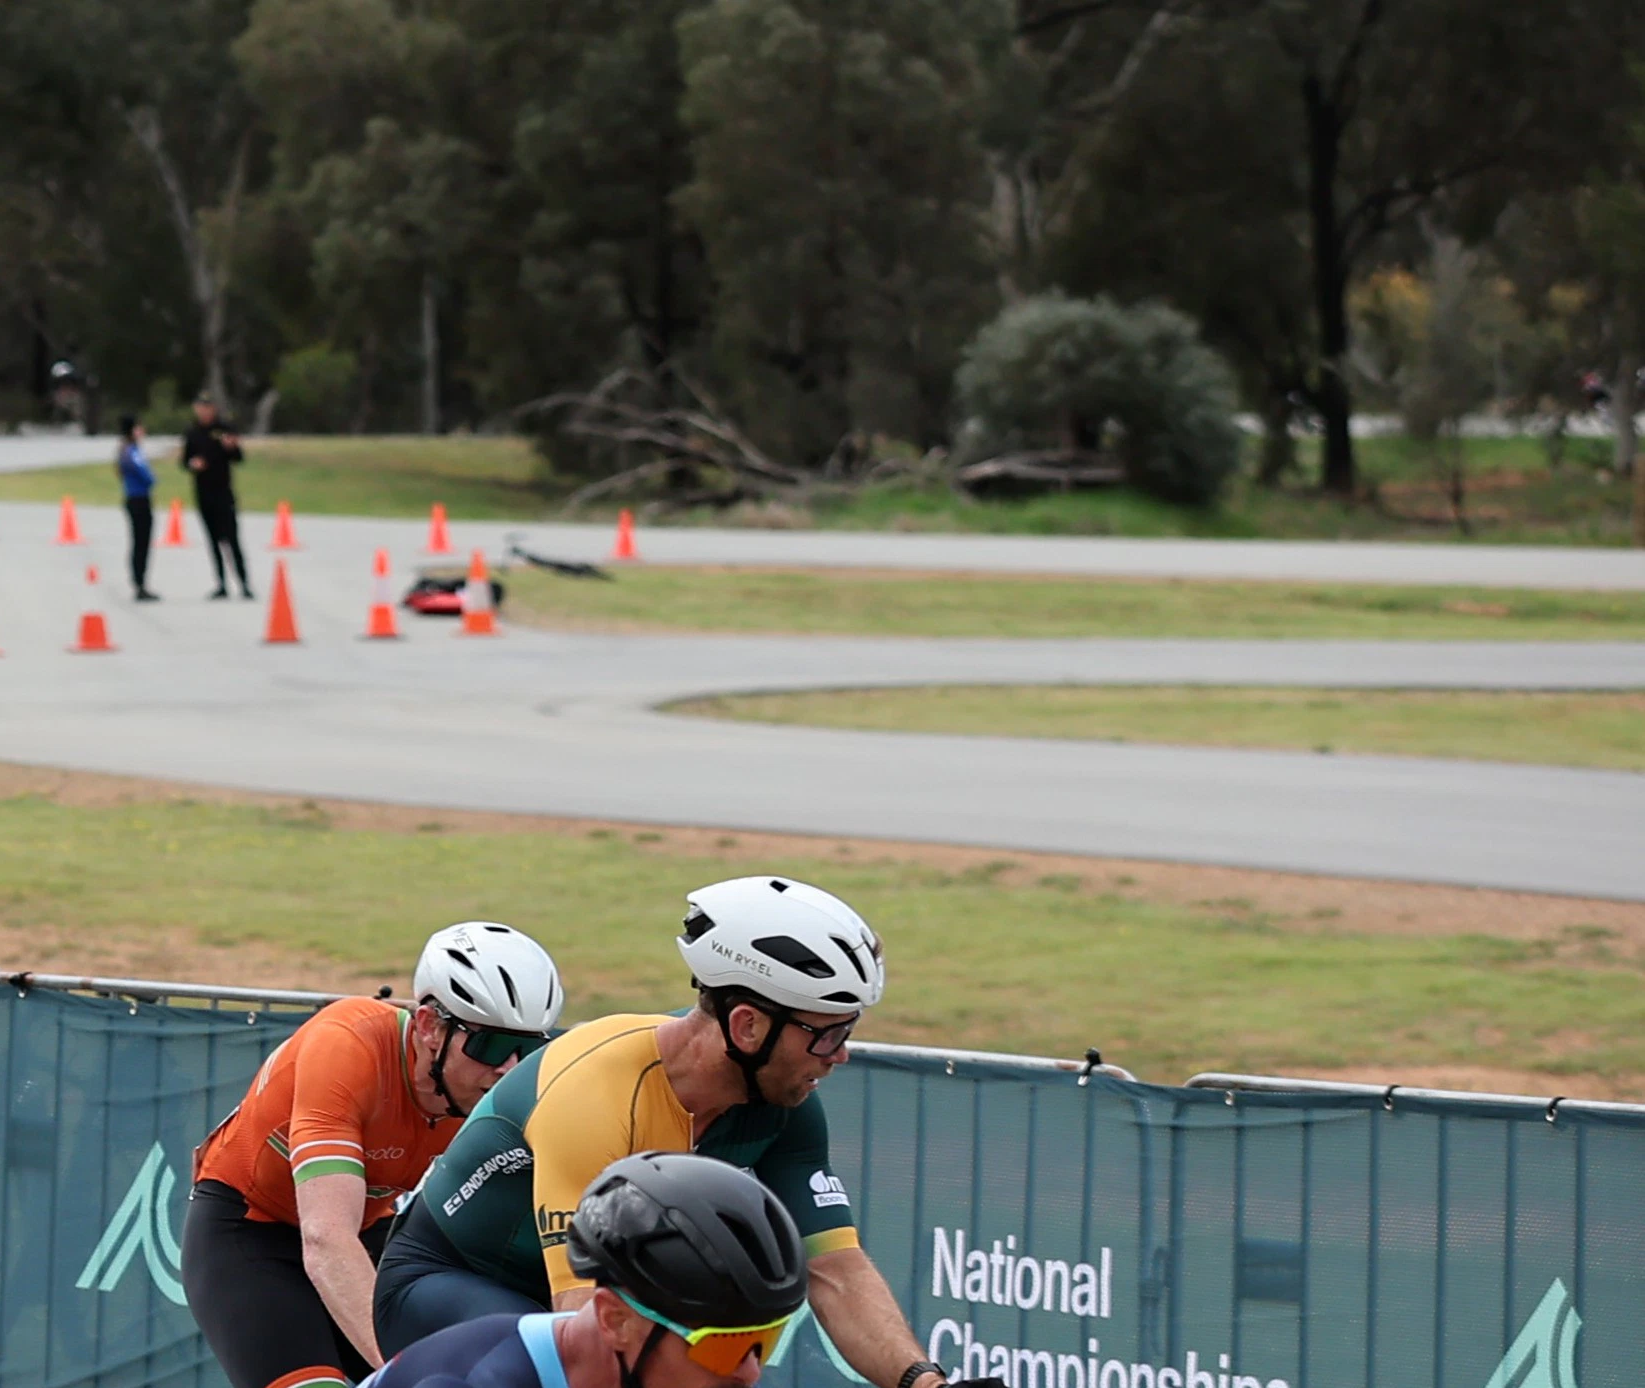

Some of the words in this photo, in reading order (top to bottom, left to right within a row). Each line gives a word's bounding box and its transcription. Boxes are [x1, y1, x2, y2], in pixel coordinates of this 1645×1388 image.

[711, 939, 734, 960] VAN
[734, 953, 774, 978] RYSEL
[459, 1147, 532, 1202] ENDEAVOUR
[932, 1226, 1112, 1318] National
